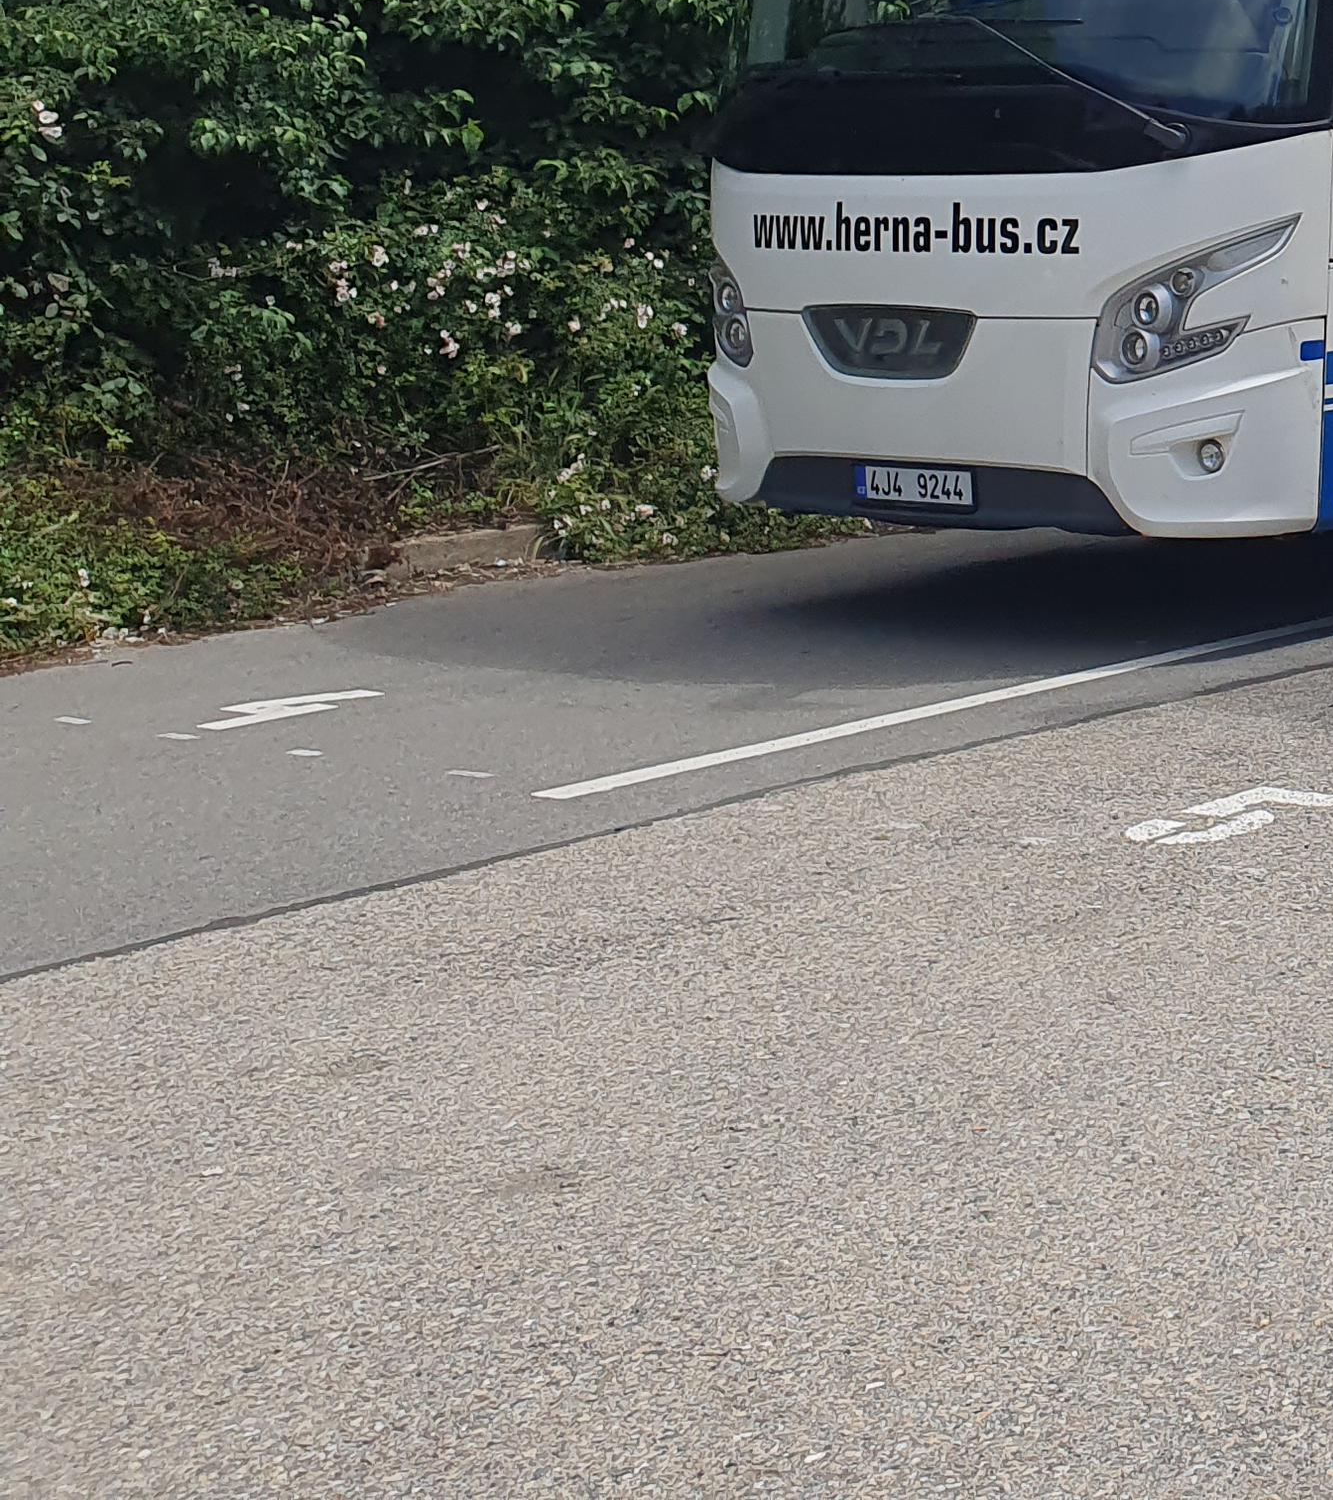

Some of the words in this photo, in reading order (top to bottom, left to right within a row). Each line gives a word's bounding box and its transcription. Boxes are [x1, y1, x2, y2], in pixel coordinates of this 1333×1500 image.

[753, 201, 1080, 255] www.herna-bus.cz
[833, 317, 943, 355] VDL
[870, 469, 903, 497] 4J4
[917, 472, 963, 500] 9244
